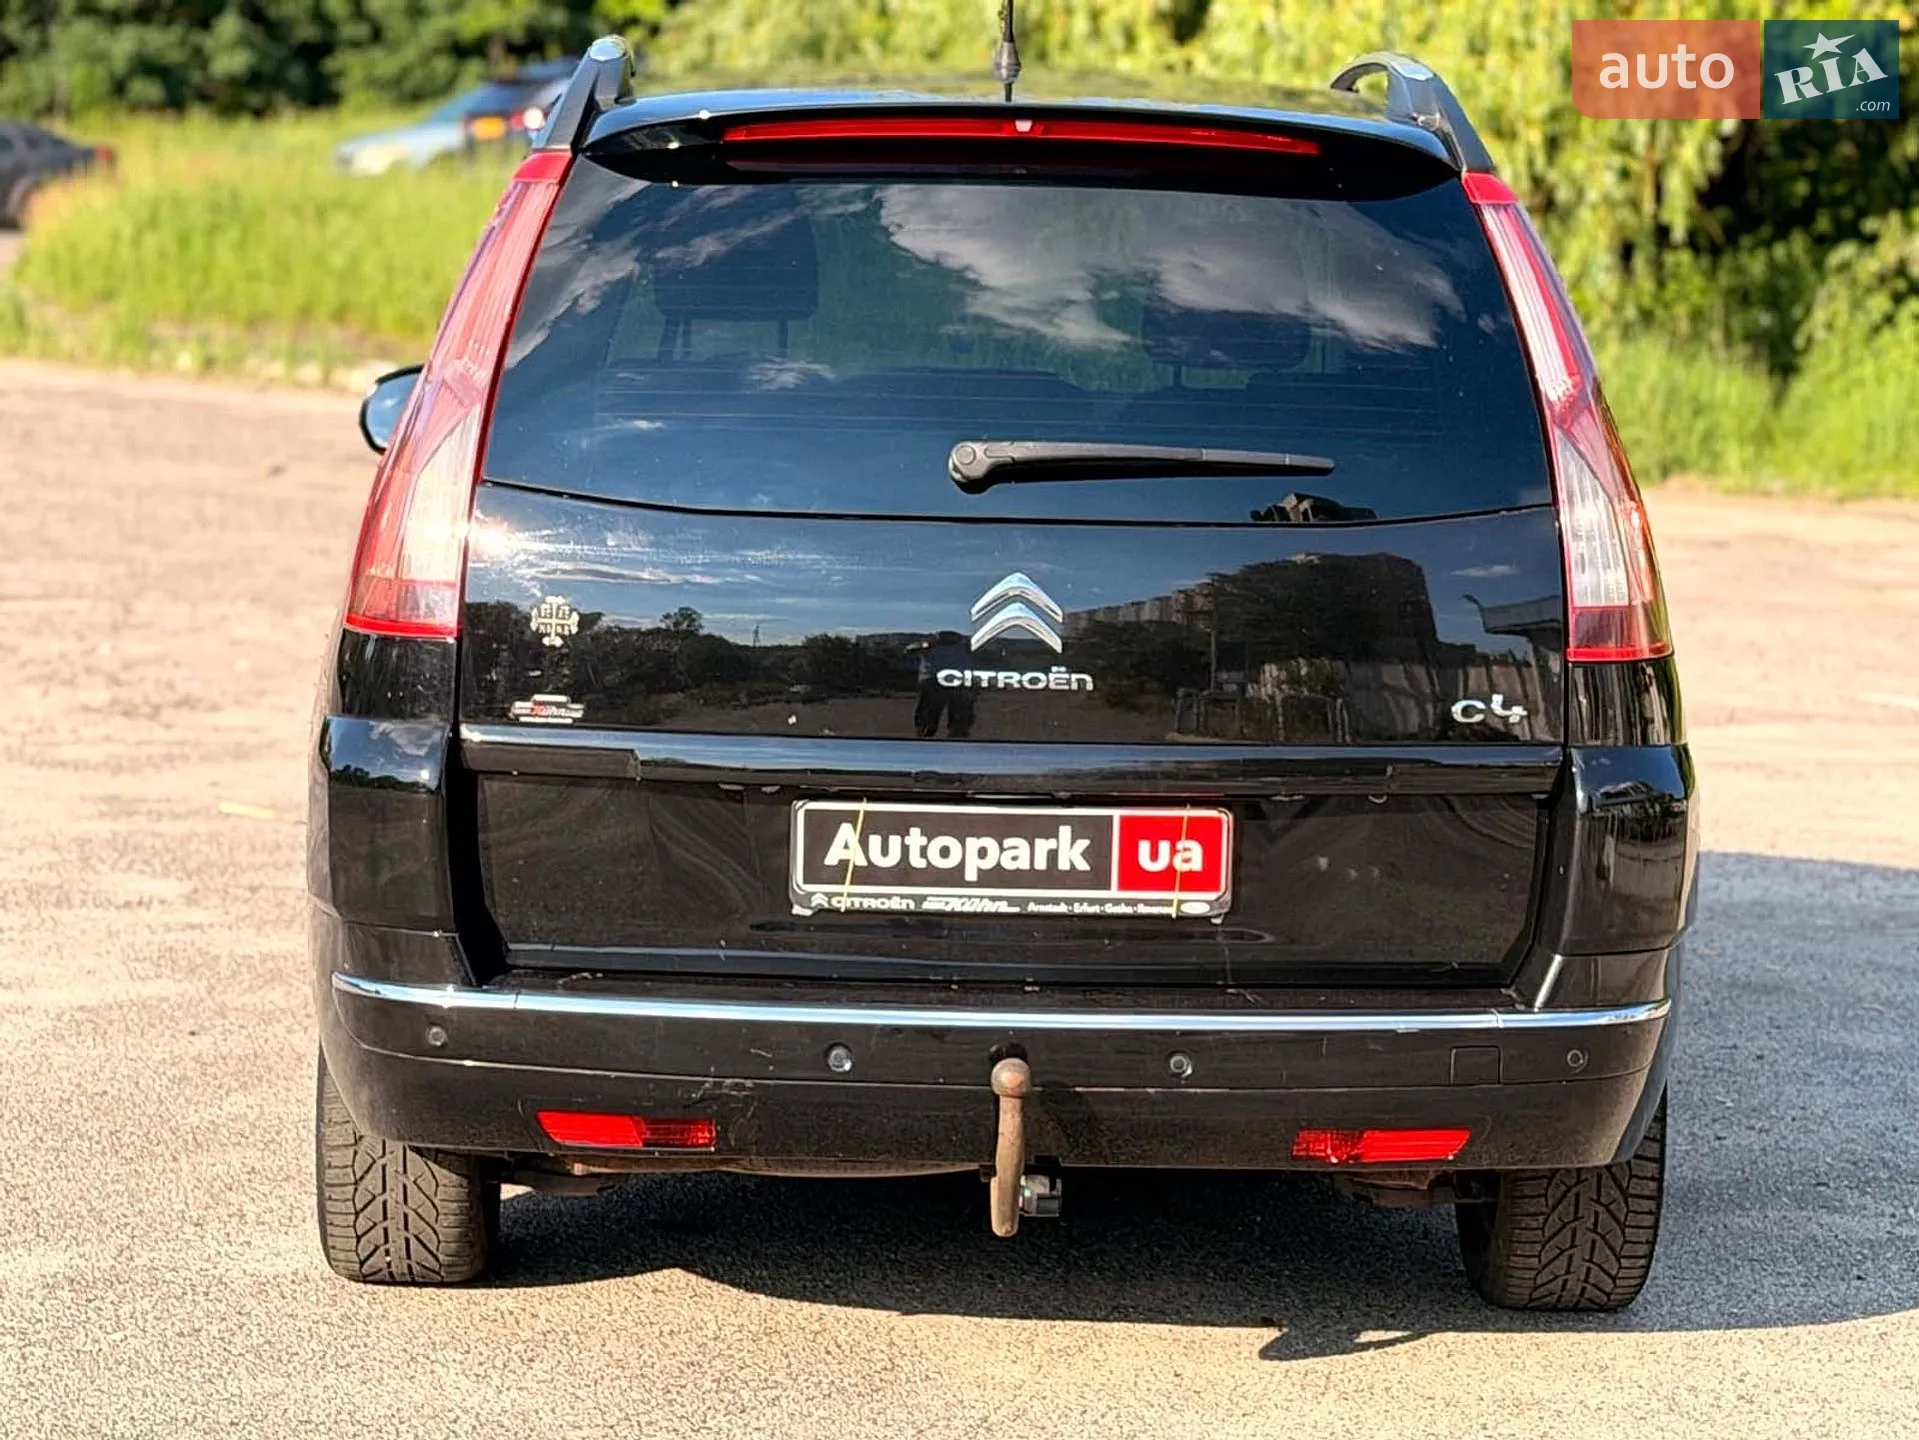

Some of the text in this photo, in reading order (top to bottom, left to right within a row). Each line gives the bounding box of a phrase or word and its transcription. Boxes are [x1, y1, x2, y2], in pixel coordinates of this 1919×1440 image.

[1451, 693, 1528, 723] C4
[823, 821, 1204, 883] Autopark ua
